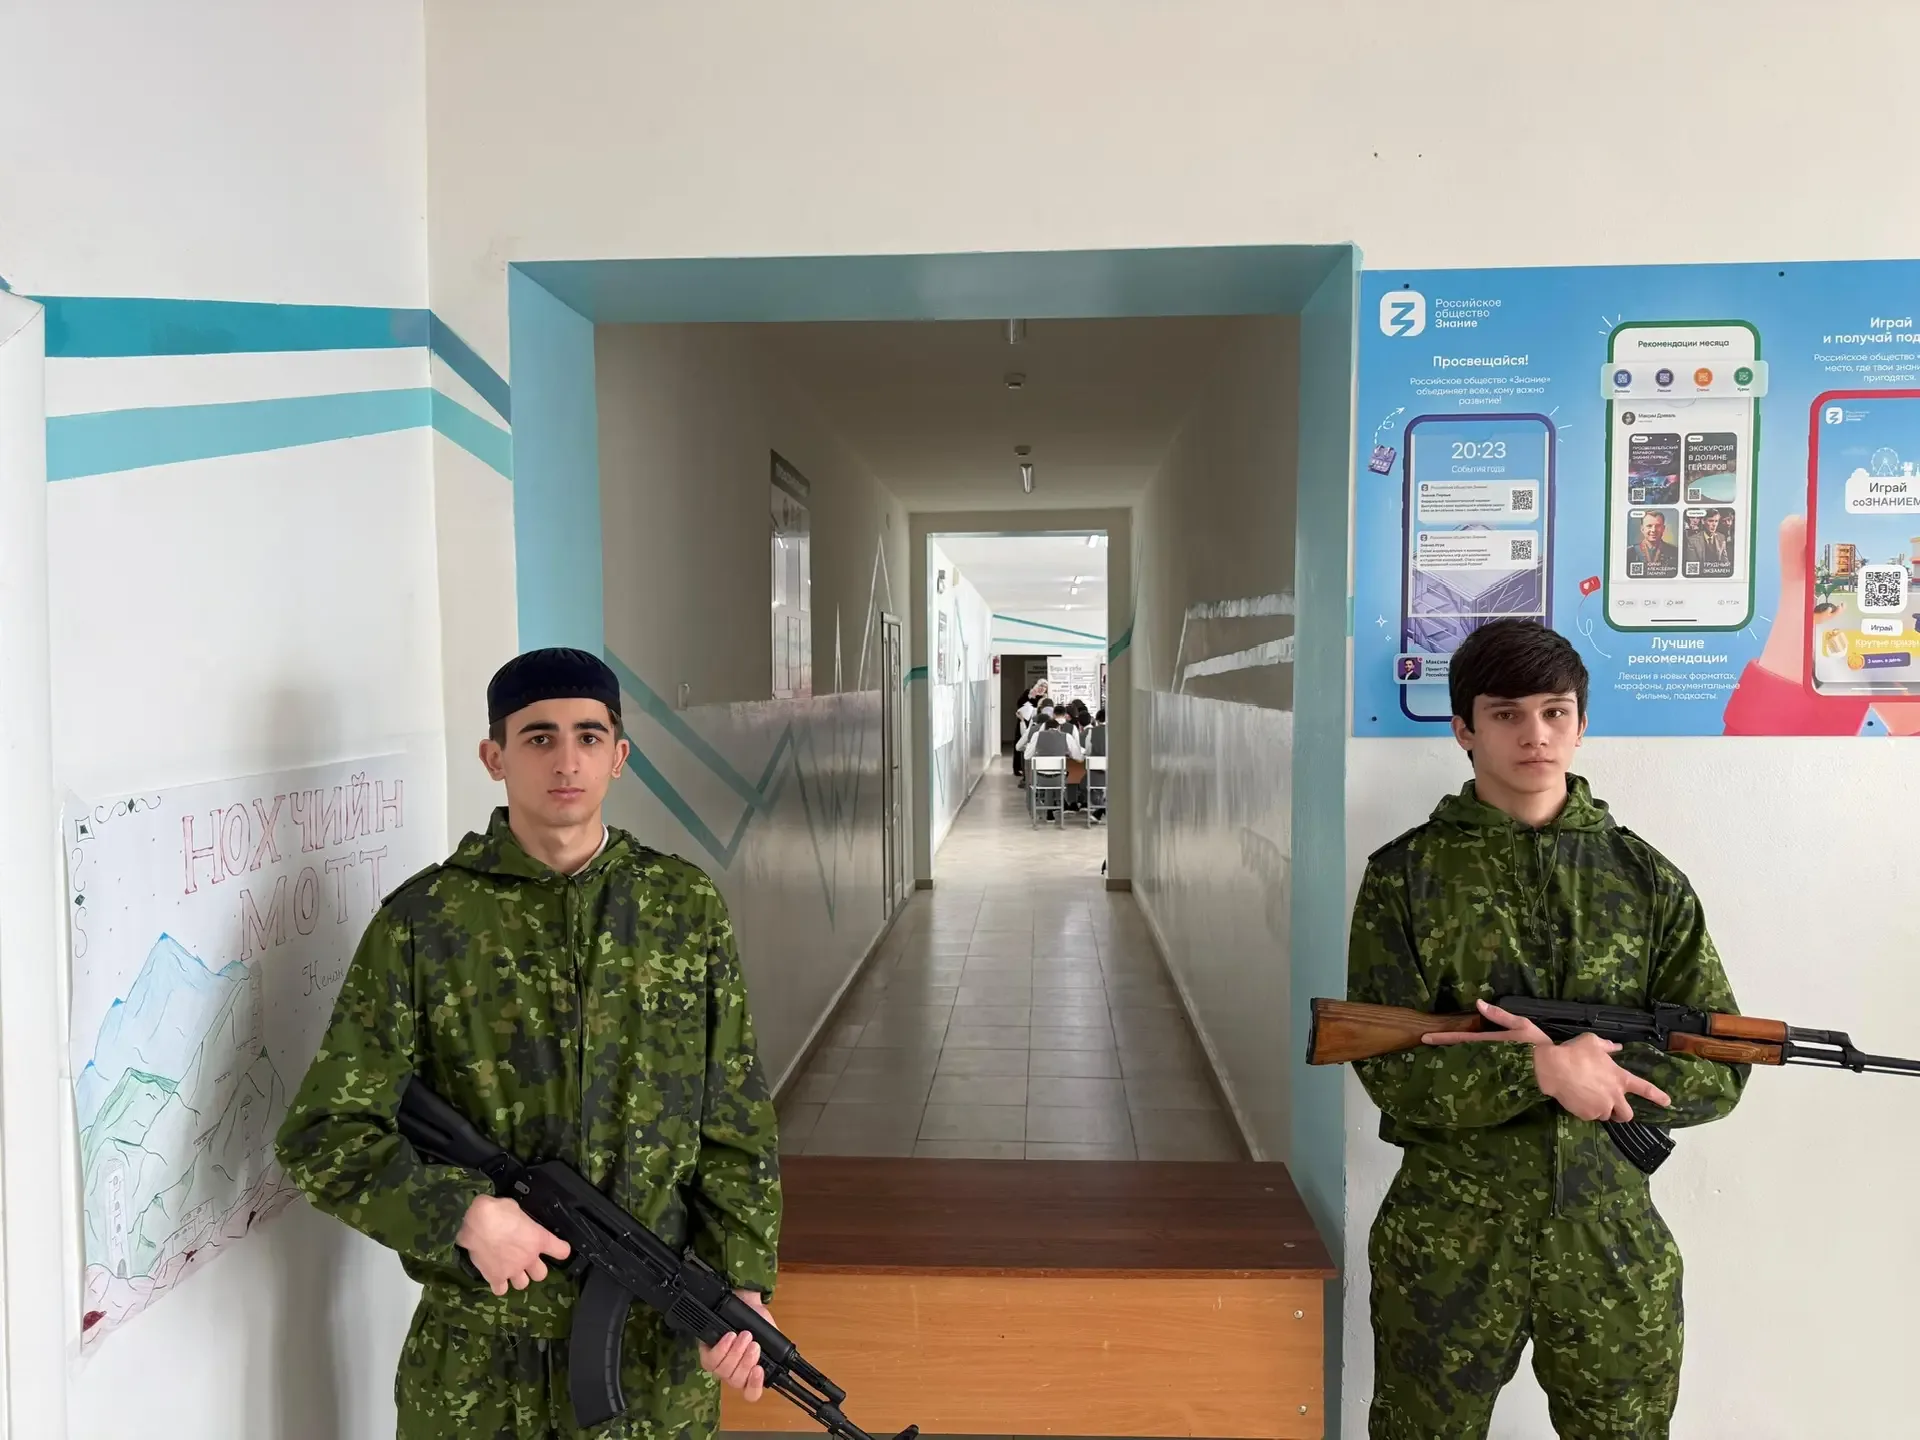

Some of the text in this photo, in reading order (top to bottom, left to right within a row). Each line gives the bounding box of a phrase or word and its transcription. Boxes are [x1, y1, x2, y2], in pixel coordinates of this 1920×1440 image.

[1435, 298, 1502, 308] Российское
[1435, 308, 1490, 319] общество
[1435, 318, 1478, 328] Знание
[1870, 316, 1913, 330] Играй
[1637, 339, 1730, 348] Рекомендации месяца
[1823, 335, 1831, 344] и
[1835, 332, 1892, 345] получай
[1433, 354, 1529, 368] Просвещайся!
[1813, 353, 1915, 362] Российское общество
[1825, 365, 1854, 373] место,
[1856, 365, 1871, 373] где
[1410, 376, 1551, 386] Российское общество «Знание»
[1863, 374, 1917, 383] пригодятся.
[1416, 386, 1545, 396] объединяет всех, кому важно
[1458, 395, 1502, 406] развитие!
[1451, 441, 1506, 459] 20:23
[1695, 454, 1727, 462] ДОЛИНЕ
[1451, 464, 1505, 474] События года
[1687, 462, 1727, 471] ГЕЙЗЕРОВ
[1869, 482, 1907, 495] Играй
[1852, 497, 1920, 507] соЗНАНИЕМ
[1871, 624, 1893, 632] Играй
[1652, 637, 1705, 651] Лучшие
[1628, 653, 1728, 666] рекомендации
[1618, 672, 1652, 681] Лекции
[1689, 671, 1737, 681] форматах,
[1614, 682, 1741, 691] марафоны, документальные
[1635, 692, 1718, 701] фильмы, подкасты.
[181, 771, 403, 895] НОХЧИЙН
[240, 845, 388, 961] МОТТ
